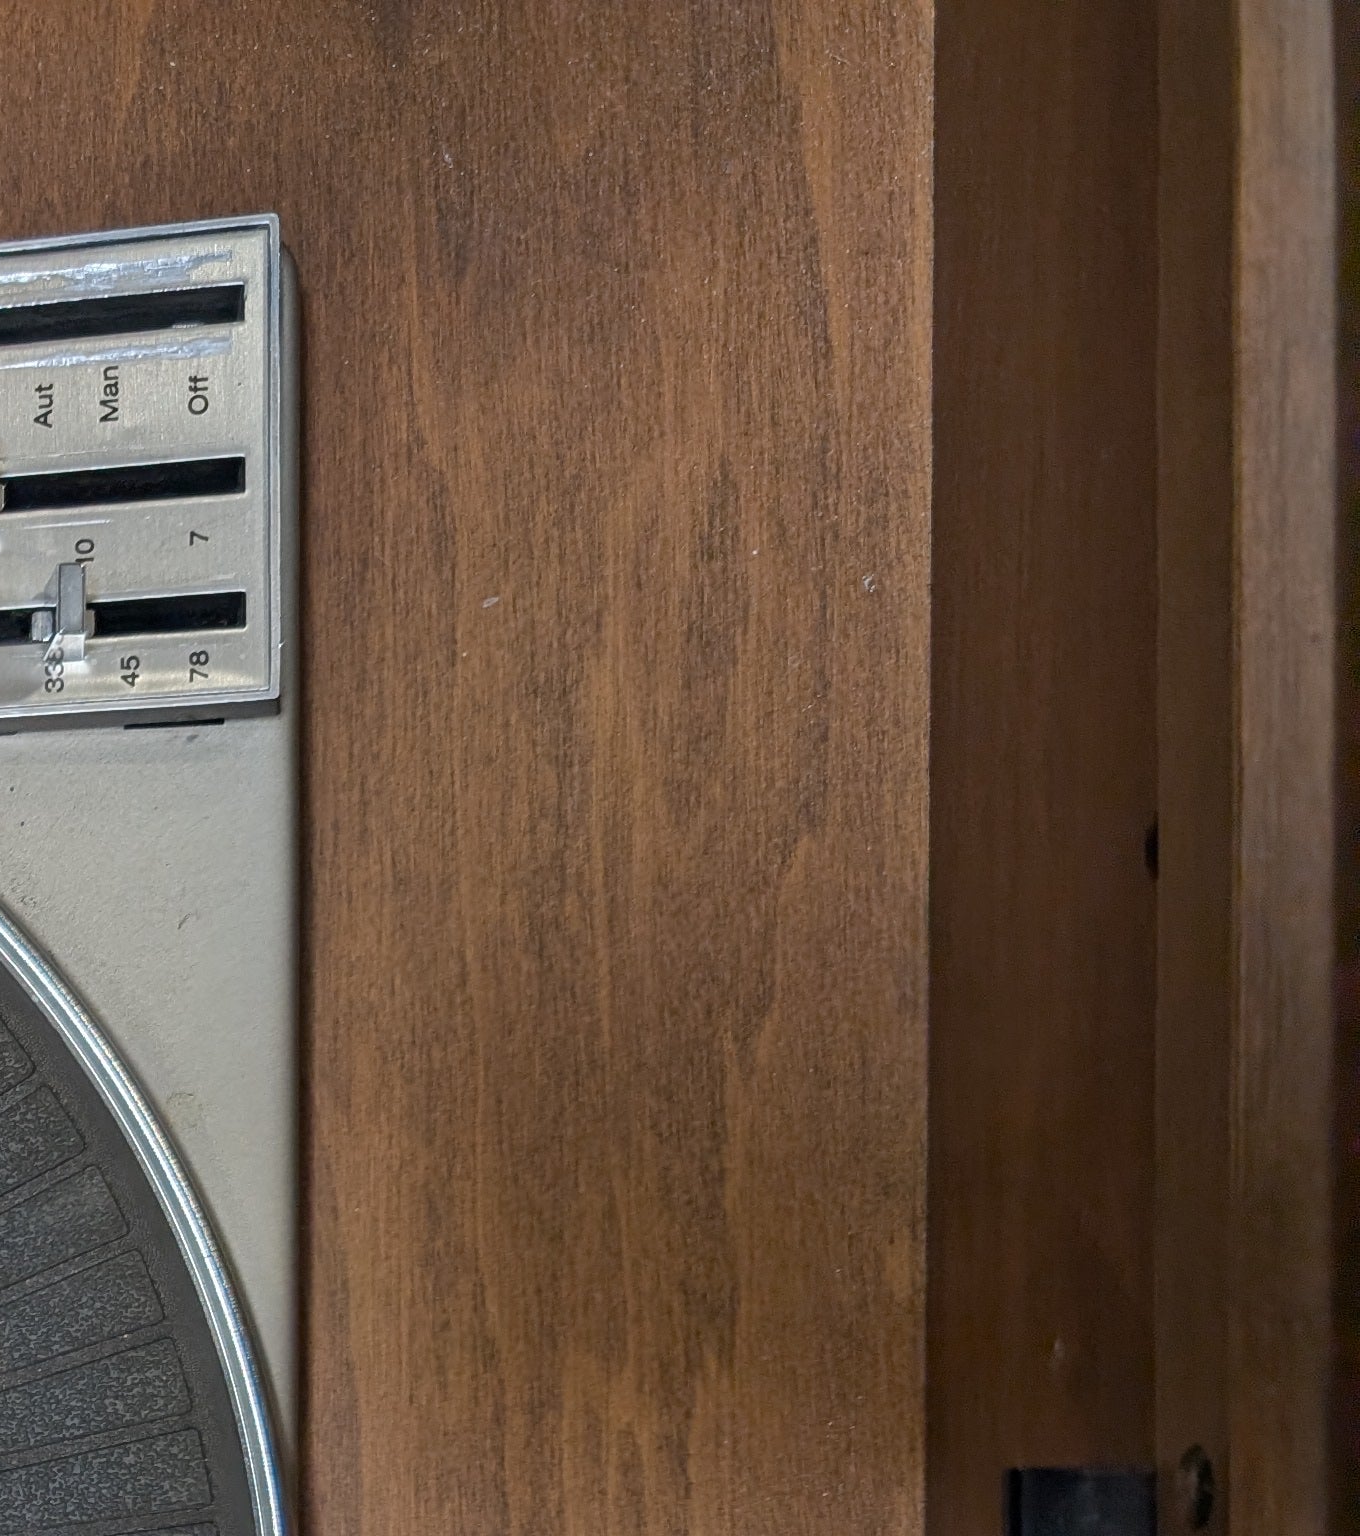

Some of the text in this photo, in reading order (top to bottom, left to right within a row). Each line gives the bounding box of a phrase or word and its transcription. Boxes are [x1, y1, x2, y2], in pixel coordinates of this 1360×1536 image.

[34, 383, 54, 428] Aut
[99, 365, 119, 422] Man
[189, 374, 209, 415] Off
[75, 538, 95, 563] 10
[190, 530, 210, 546] 7
[120, 655, 140, 687] 45
[189, 649, 209, 682] 78
